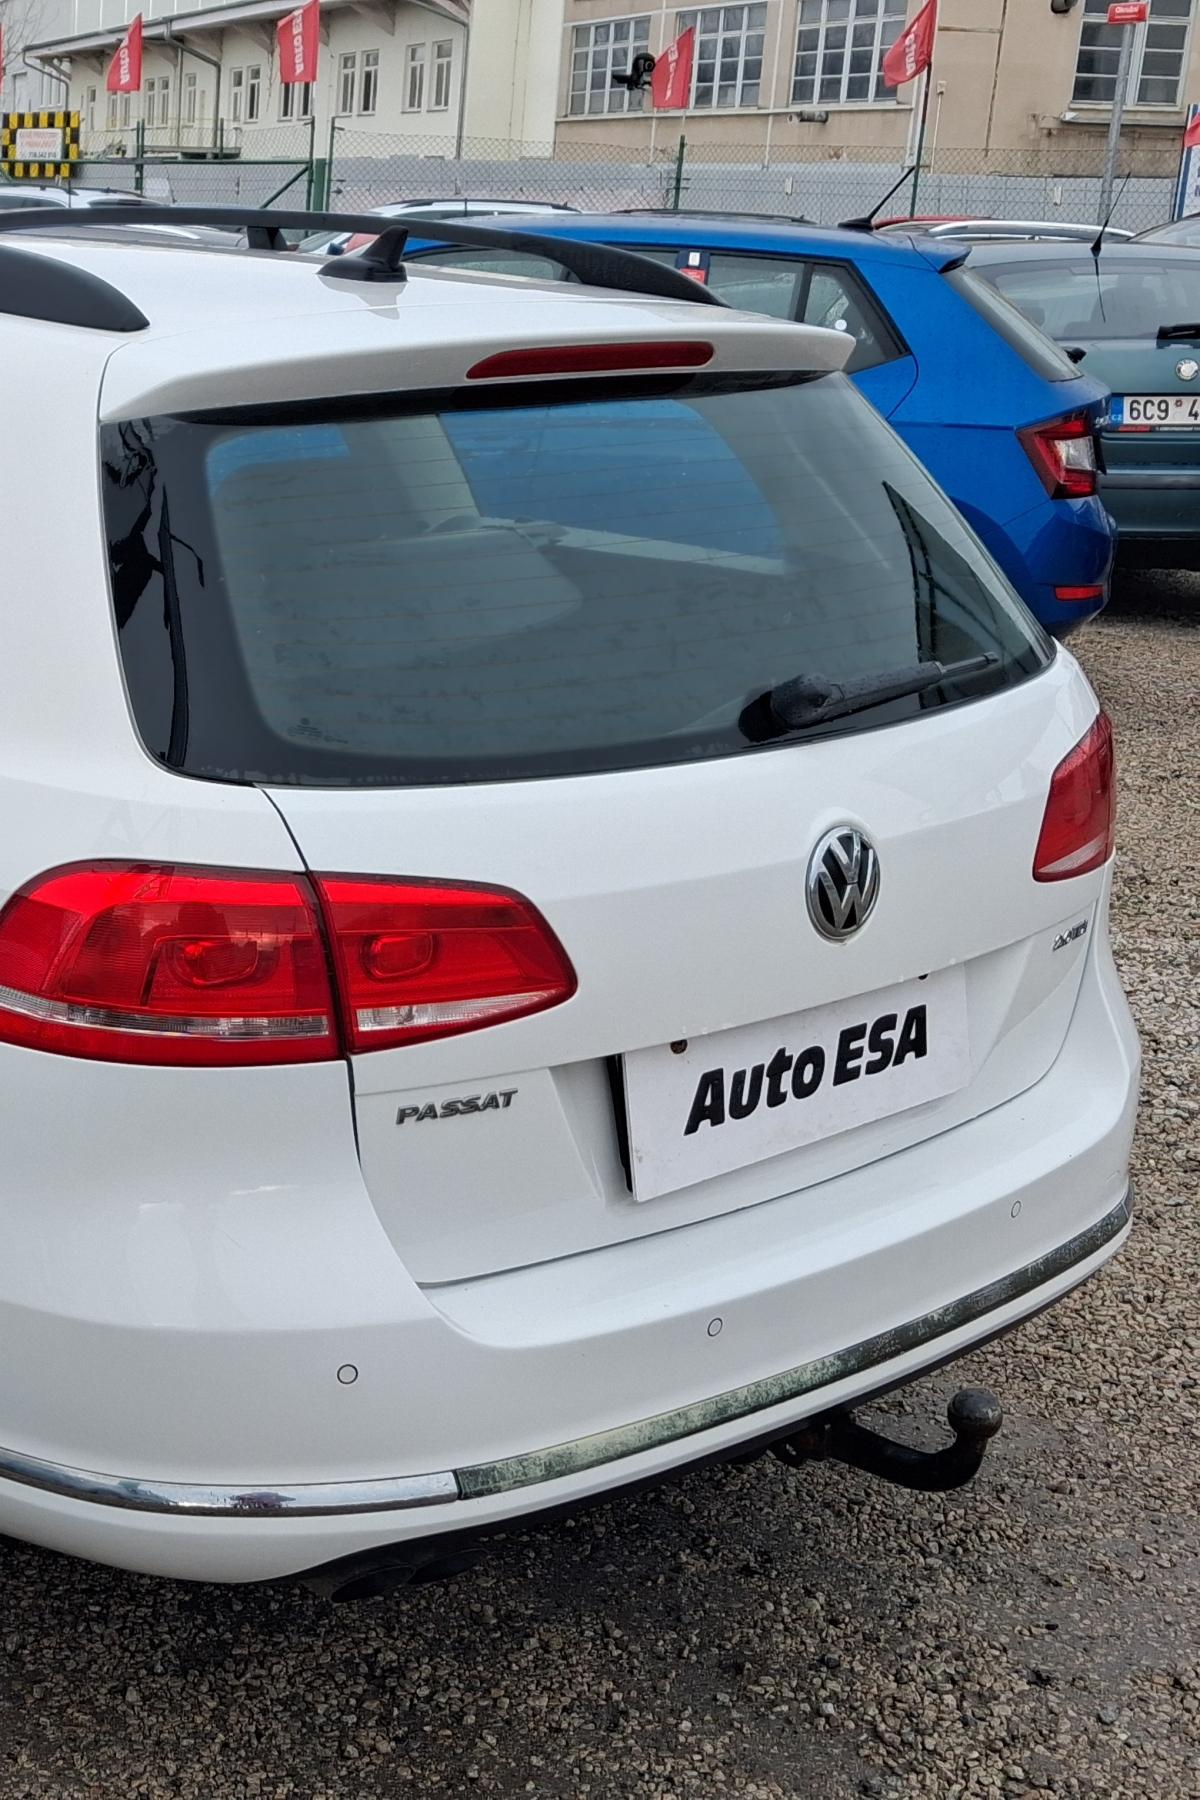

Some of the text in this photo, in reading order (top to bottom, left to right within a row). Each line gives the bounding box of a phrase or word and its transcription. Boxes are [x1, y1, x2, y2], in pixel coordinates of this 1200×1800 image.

[1129, 399, 1170, 421] 6C9
[684, 1004, 927, 1136] Auto ESA
[396, 1088, 518, 1125] PASSAT
